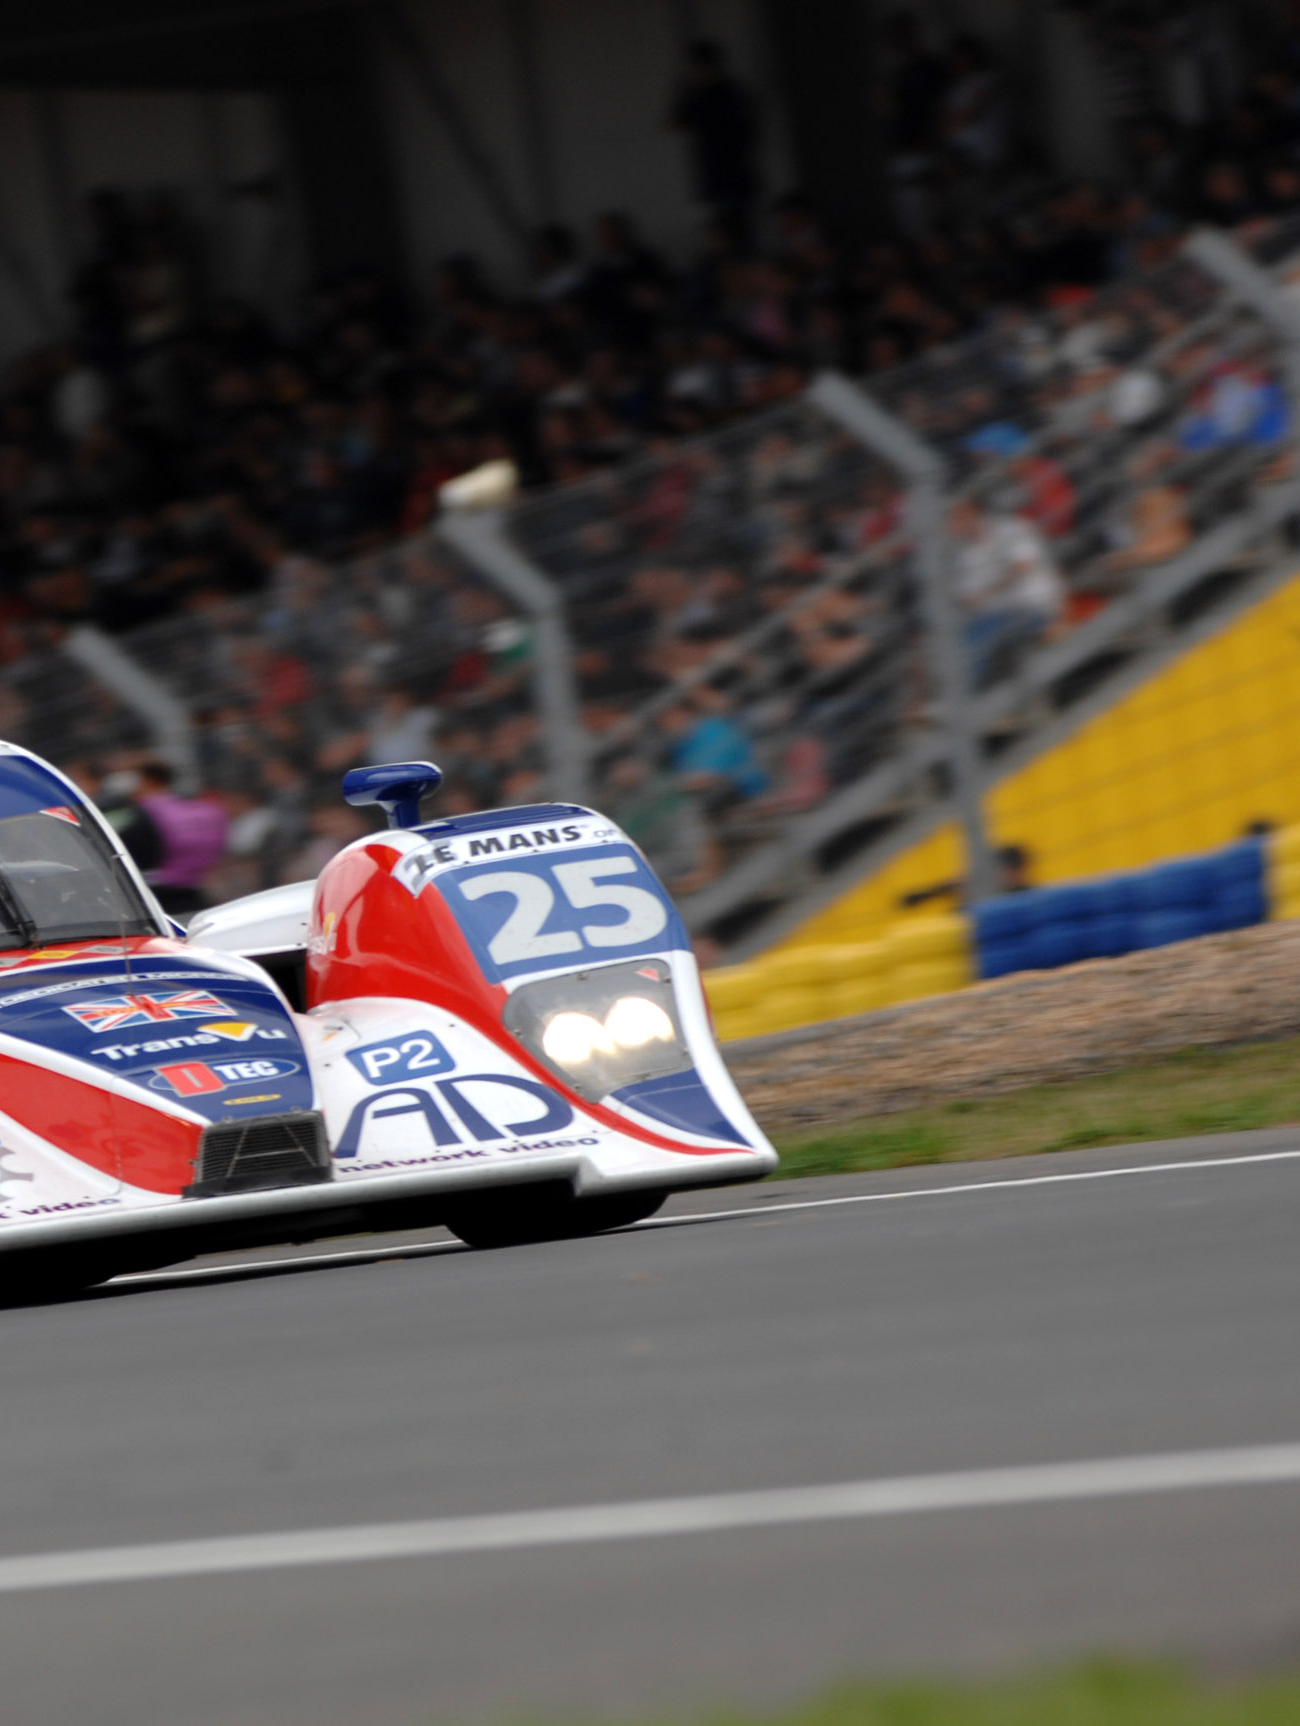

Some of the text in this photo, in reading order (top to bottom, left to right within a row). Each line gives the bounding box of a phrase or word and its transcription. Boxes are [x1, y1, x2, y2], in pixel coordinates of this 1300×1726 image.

[467, 825, 580, 858] MANS
[458, 855, 668, 965] 25
[360, 1038, 441, 1079] P2
[334, 1073, 574, 1160] AD
[338, 1135, 602, 1174] network video
[20, 1197, 122, 1217] video
